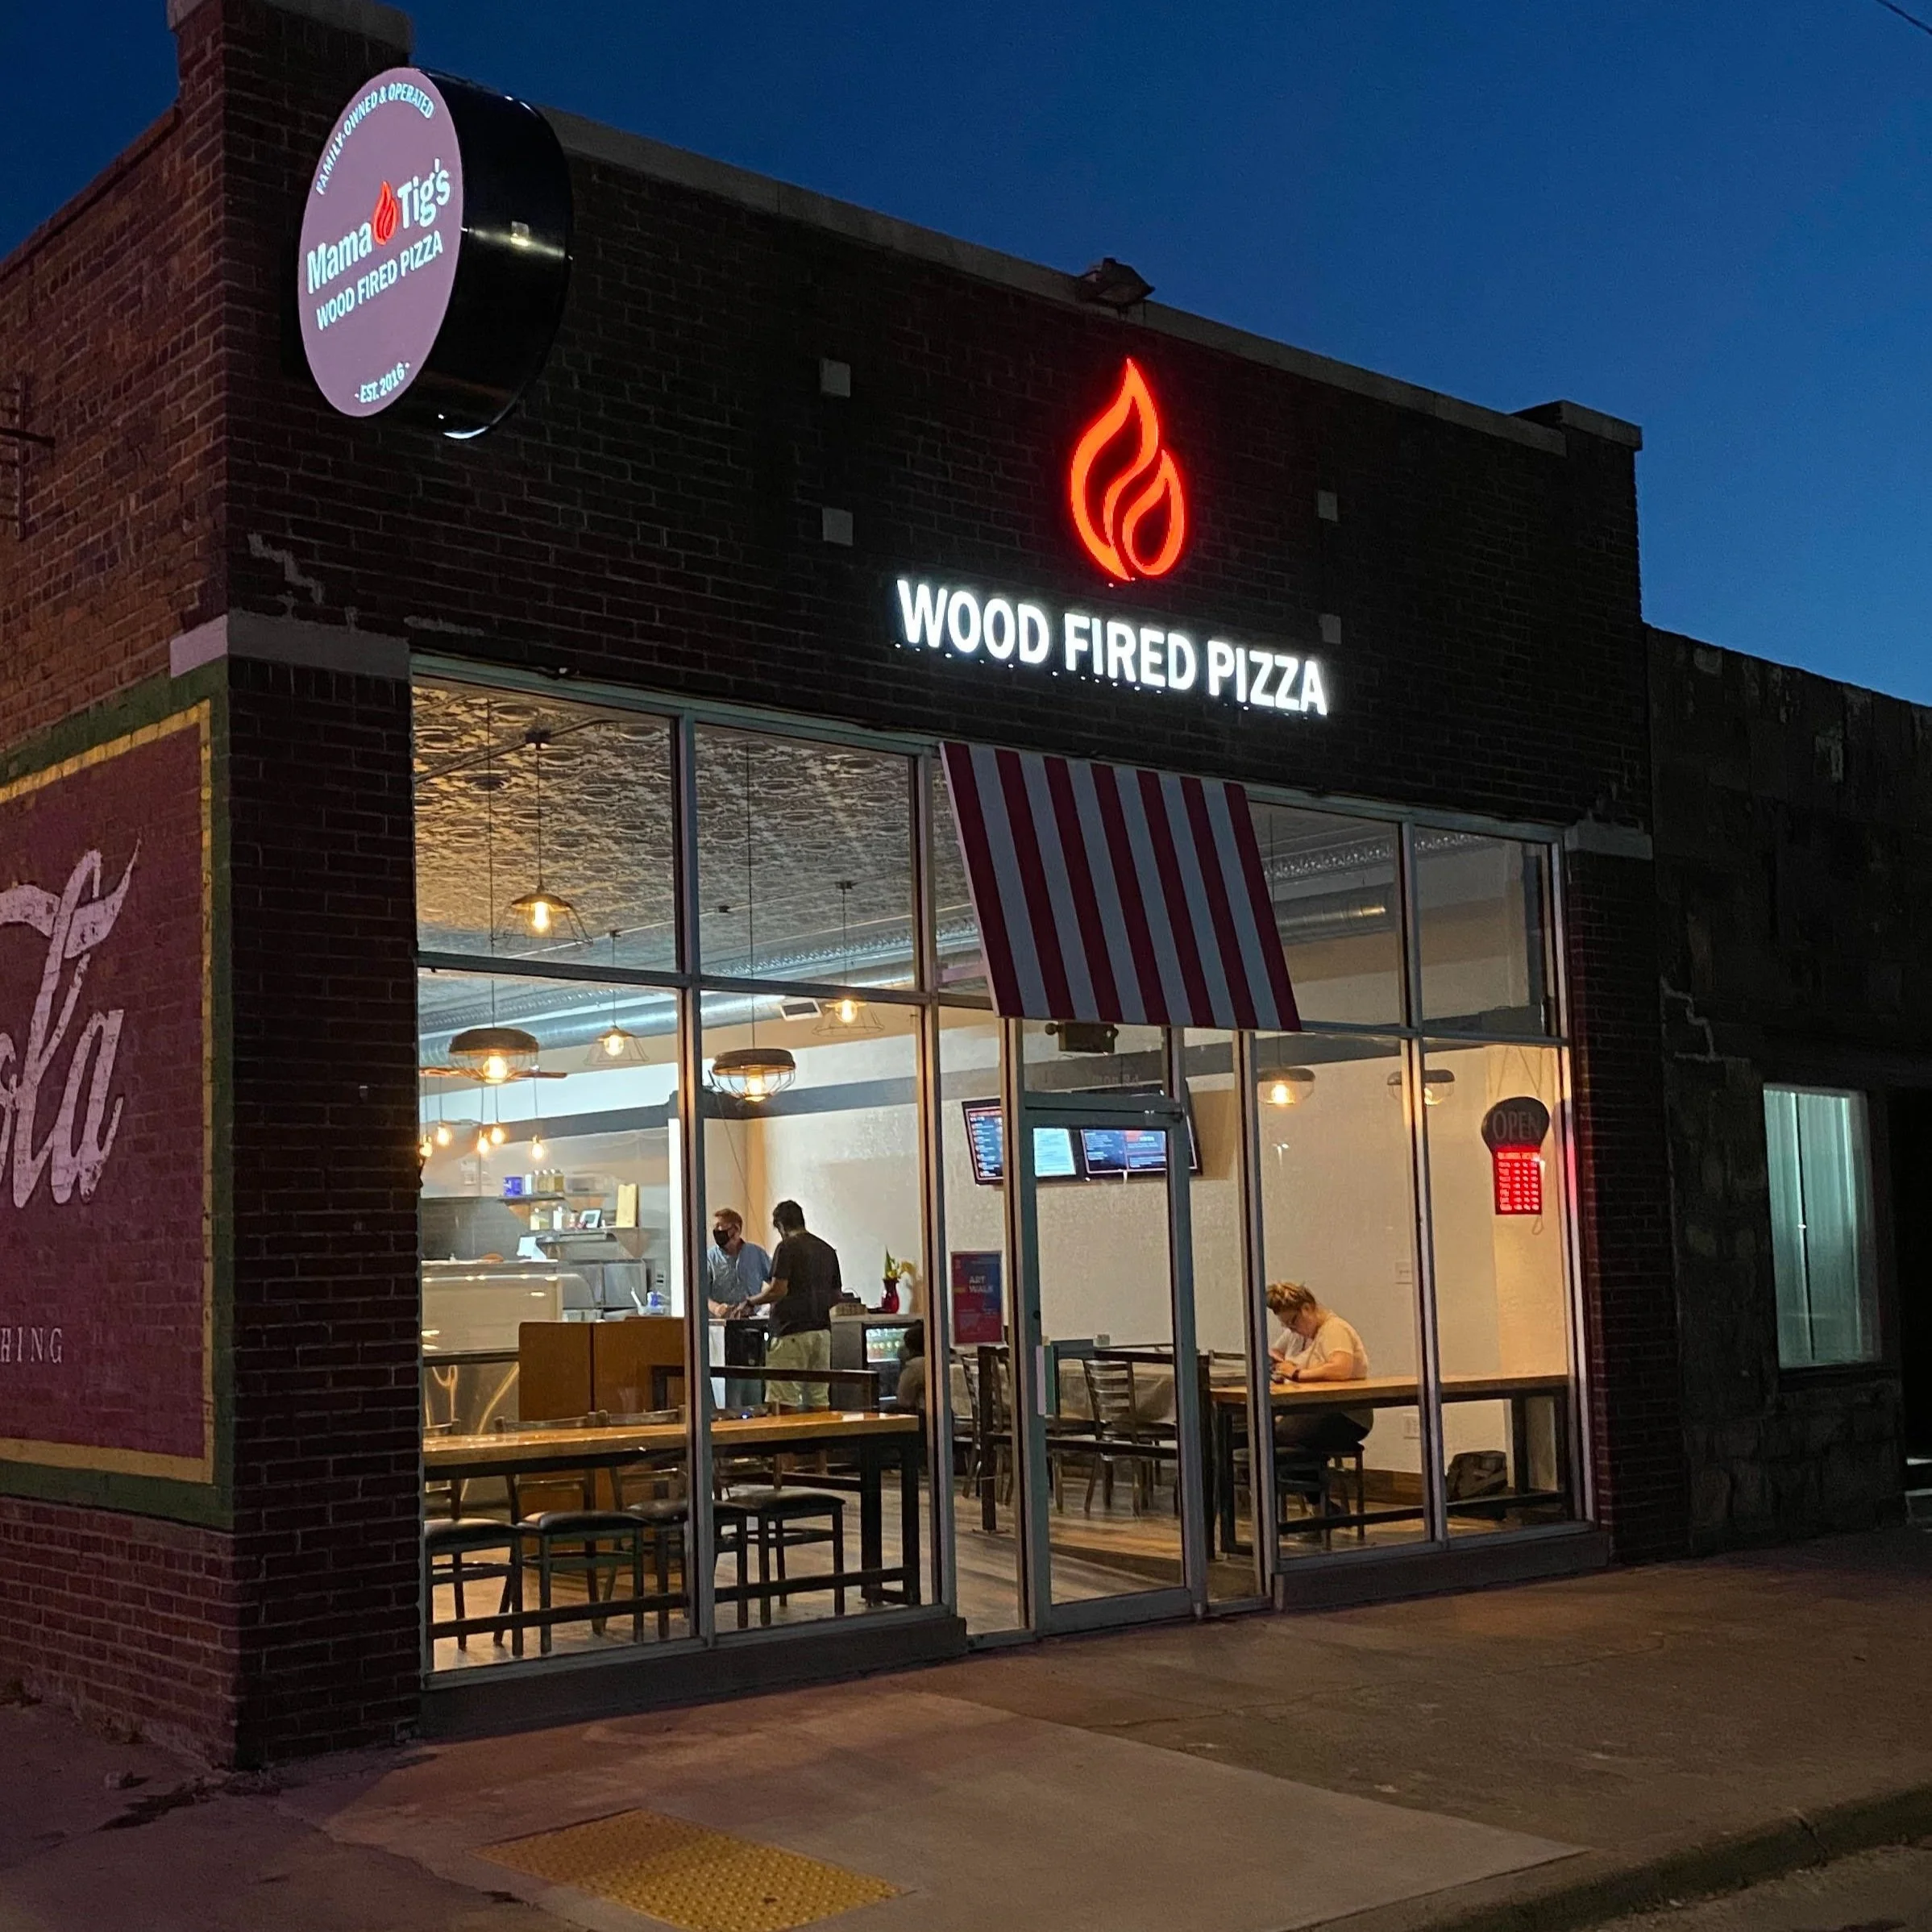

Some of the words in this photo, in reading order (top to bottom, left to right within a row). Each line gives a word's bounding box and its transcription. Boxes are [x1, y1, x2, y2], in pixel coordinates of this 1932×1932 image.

[379, 85, 388, 104] &
[388, 83, 434, 119] OPERATED
[307, 222, 372, 295] Mama
[397, 158, 451, 229] Tig's
[316, 286, 355, 331] WOOD
[357, 259, 398, 305] FIRED
[400, 230, 443, 277] PIZZA
[379, 362, 405, 397] 2016
[896, 578, 1050, 665] WOOD
[1063, 612, 1197, 692] FIRED
[1207, 639, 1328, 716] PIZZA
[1492, 1110, 1542, 1141] OPEN
